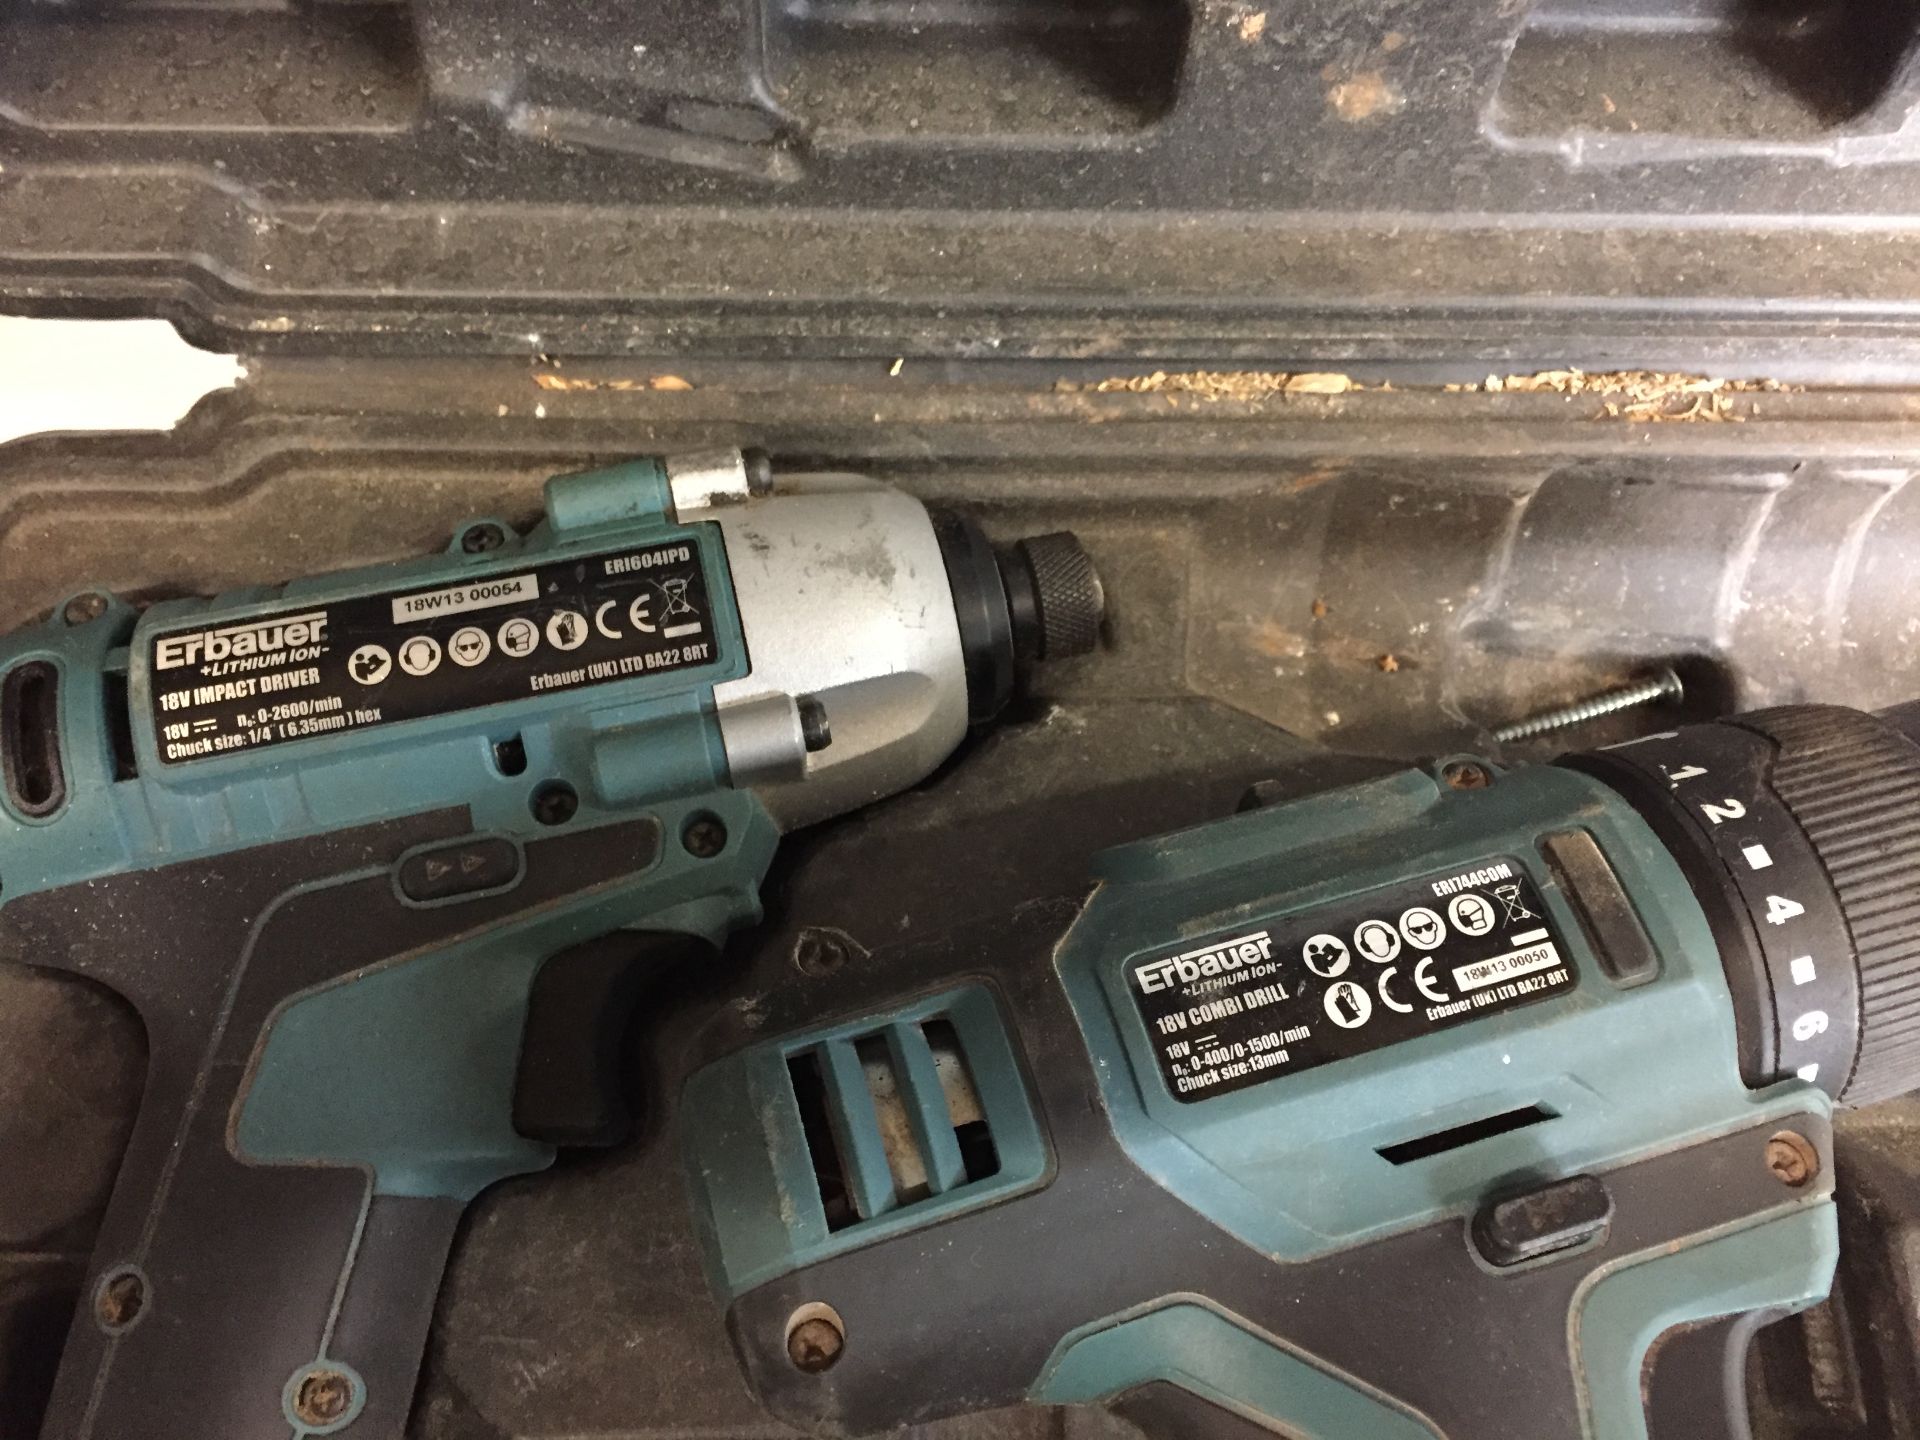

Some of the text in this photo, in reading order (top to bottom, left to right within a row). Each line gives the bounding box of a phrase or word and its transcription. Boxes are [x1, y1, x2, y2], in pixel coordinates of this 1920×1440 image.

[604, 546, 690, 576] ERI604IPD
[404, 582, 523, 613] 18W13 00054
[156, 611, 328, 671] Erbauer
[531, 644, 709, 691] Erbauer (UK) LTD BA22 8RT
[159, 667, 320, 711] 18V IMPACT DRIVER
[258, 695, 342, 723] 0-2600/min
[163, 721, 189, 741] 18V
[167, 738, 213, 760] Chuck
[215, 731, 247, 750] size:
[288, 713, 345, 735] 6.35mm
[355, 707, 381, 723] hex
[1432, 864, 1513, 898] ERI744COM
[1135, 931, 1272, 994] Erbauer
[1510, 948, 1550, 970] 00050
[1156, 983, 1290, 1035] 18V COMBI DRILL
[1426, 968, 1570, 1022] Erbauer (UK) LTD BA22 8RT
[1166, 1041, 1191, 1060] 18V
[1177, 1070, 1221, 1093] Chuck
